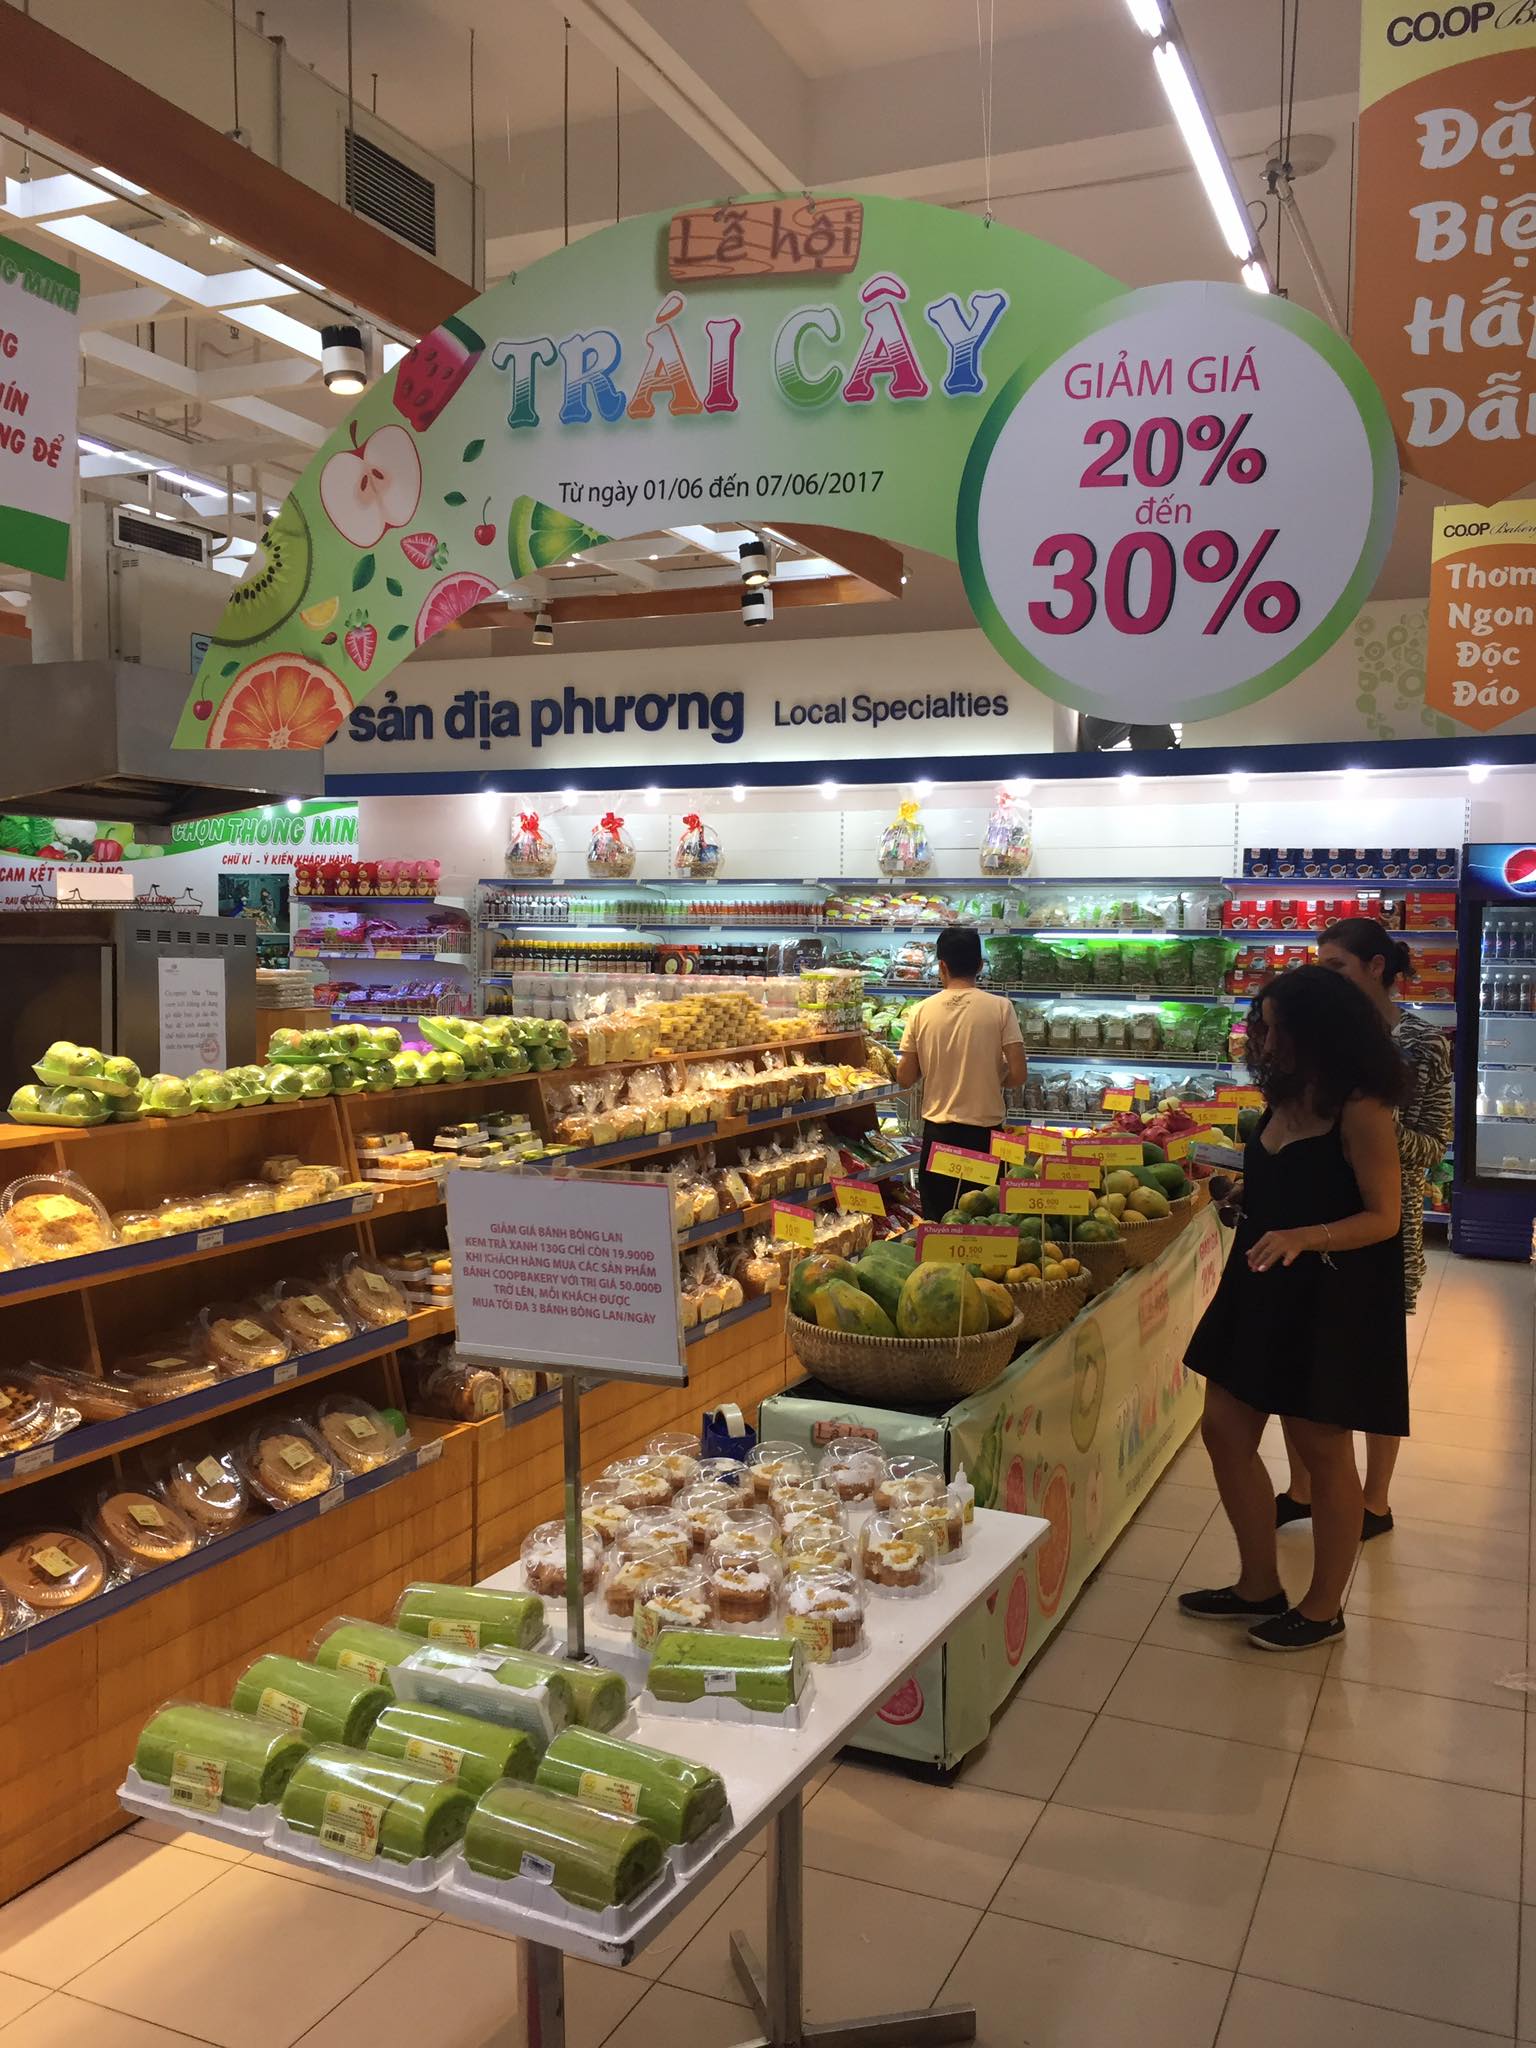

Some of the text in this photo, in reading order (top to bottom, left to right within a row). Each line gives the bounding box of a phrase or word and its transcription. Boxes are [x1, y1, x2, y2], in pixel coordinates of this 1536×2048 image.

[1387, 2, 1495, 47] CO.OP
[673, 206, 852, 271] Lễ hội
[491, 274, 1007, 429] TRÁI CÂY
[1064, 346, 1260, 400] GIẢM GIÁ
[32, 433, 65, 469] ĐỂ
[1079, 412, 1268, 488] 20%
[558, 470, 885, 507] Từ ngày 01/06 đến 07/06/2017
[1135, 493, 1193, 525] đến
[1443, 522, 1490, 538] CO.OP
[1028, 528, 1301, 636] 30%
[1445, 562, 1536, 589] Thơm
[1448, 602, 1534, 636] Ngon
[1456, 641, 1521, 674] Độc
[1452, 679, 1520, 707] Đáo
[349, 687, 1009, 750] sản địa phương Local Specialties
[172, 818, 225, 847] CHỌN
[29, 862, 55, 882] KẾT
[465, 1237, 486, 1247] KEM
[509, 1239, 538, 1251] XANH
[490, 1221, 517, 1234] GIẢM
[519, 1223, 536, 1237] GIÁ
[602, 1231, 623, 1242] LAN
[465, 1252, 482, 1262] KHI
[484, 1253, 519, 1265] KHÁCH
[521, 1255, 550, 1268] HÀNG
[552, 1259, 576, 1270] MUA
[463, 1265, 490, 1278] BÁNH
[599, 1277, 617, 1289] GIÁ
[619, 1280, 662, 1294] 50.000Đ
[472, 1297, 495, 1308] MUA
[514, 1301, 529, 1312] ĐA
[531, 1303, 537, 1313] 3
[539, 1303, 568, 1315] BÁNH
[562, 1289, 597, 1303] KHÁCH
[599, 1294, 631, 1308] ĐƯỢC
